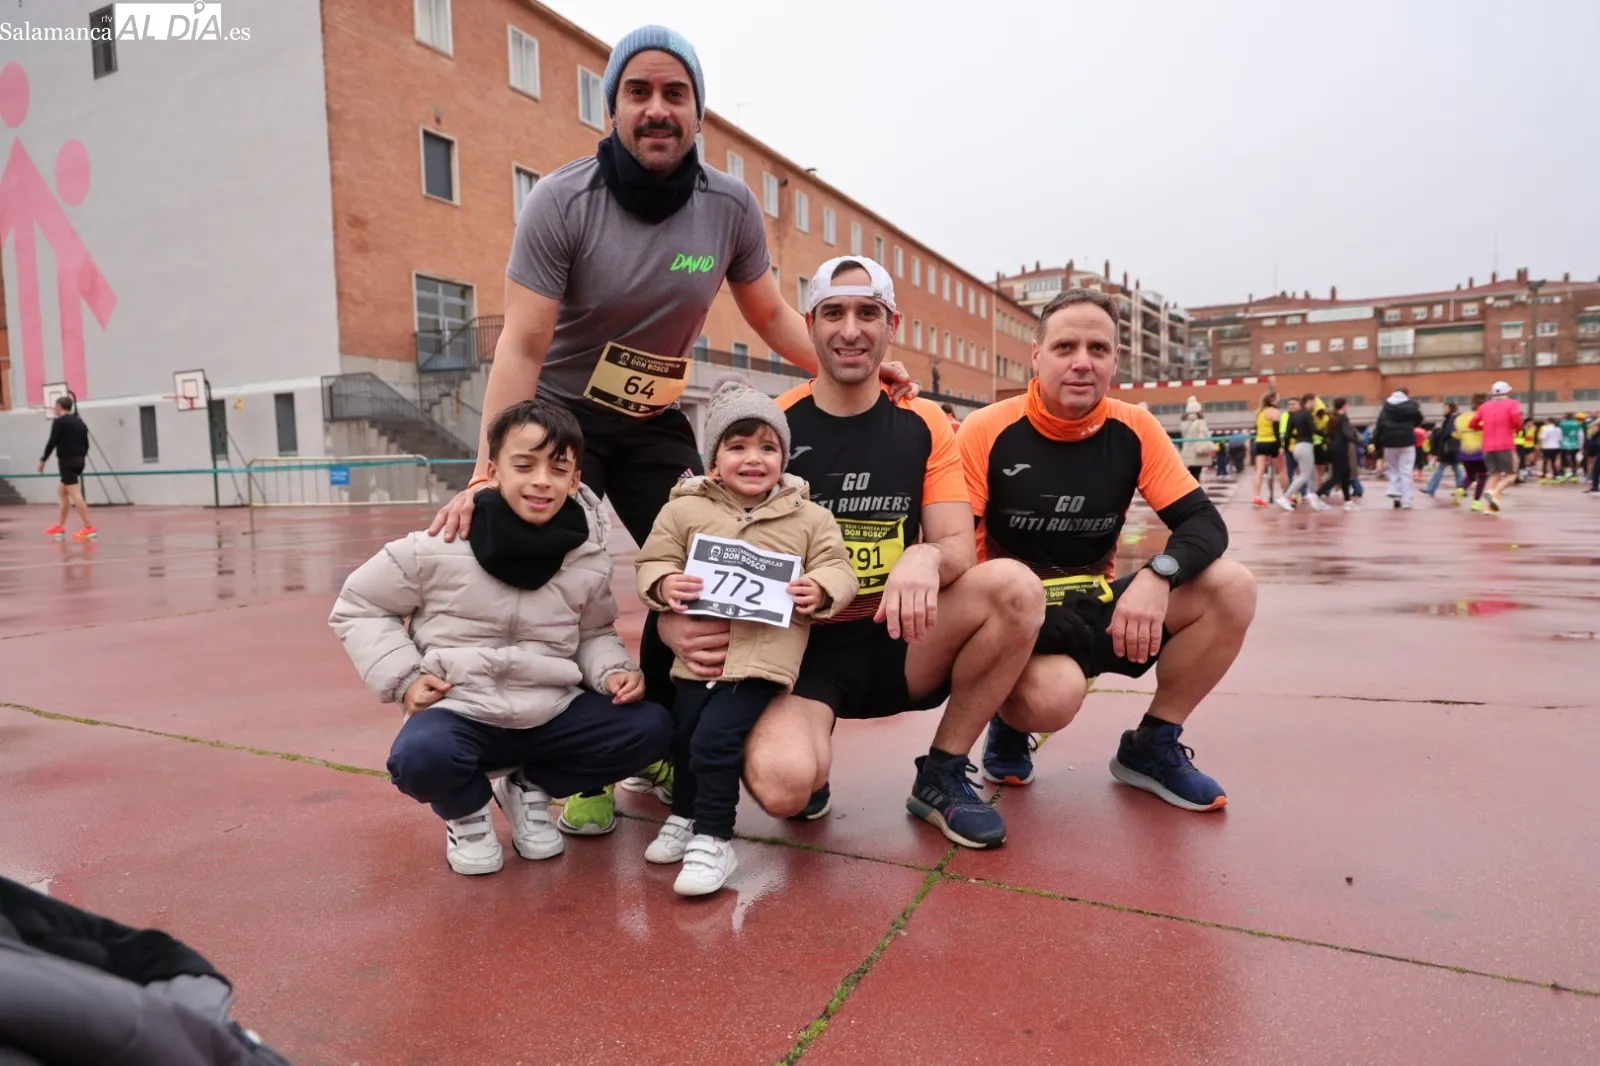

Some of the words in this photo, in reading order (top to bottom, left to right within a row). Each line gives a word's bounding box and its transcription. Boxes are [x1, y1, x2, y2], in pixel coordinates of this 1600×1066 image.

[669, 252, 715, 274] DAVID
[631, 359, 646, 368] DON
[647, 364, 669, 373] BOSCO
[624, 376, 655, 399] 64
[841, 472, 871, 491] GO
[837, 496, 911, 513] RUNNERS
[1054, 495, 1085, 513] GO
[1009, 515, 1045, 531] VITI
[844, 529, 861, 537] DON
[723, 552, 740, 560] DON
[741, 555, 766, 571] BOSCO
[711, 570, 765, 605] 772
